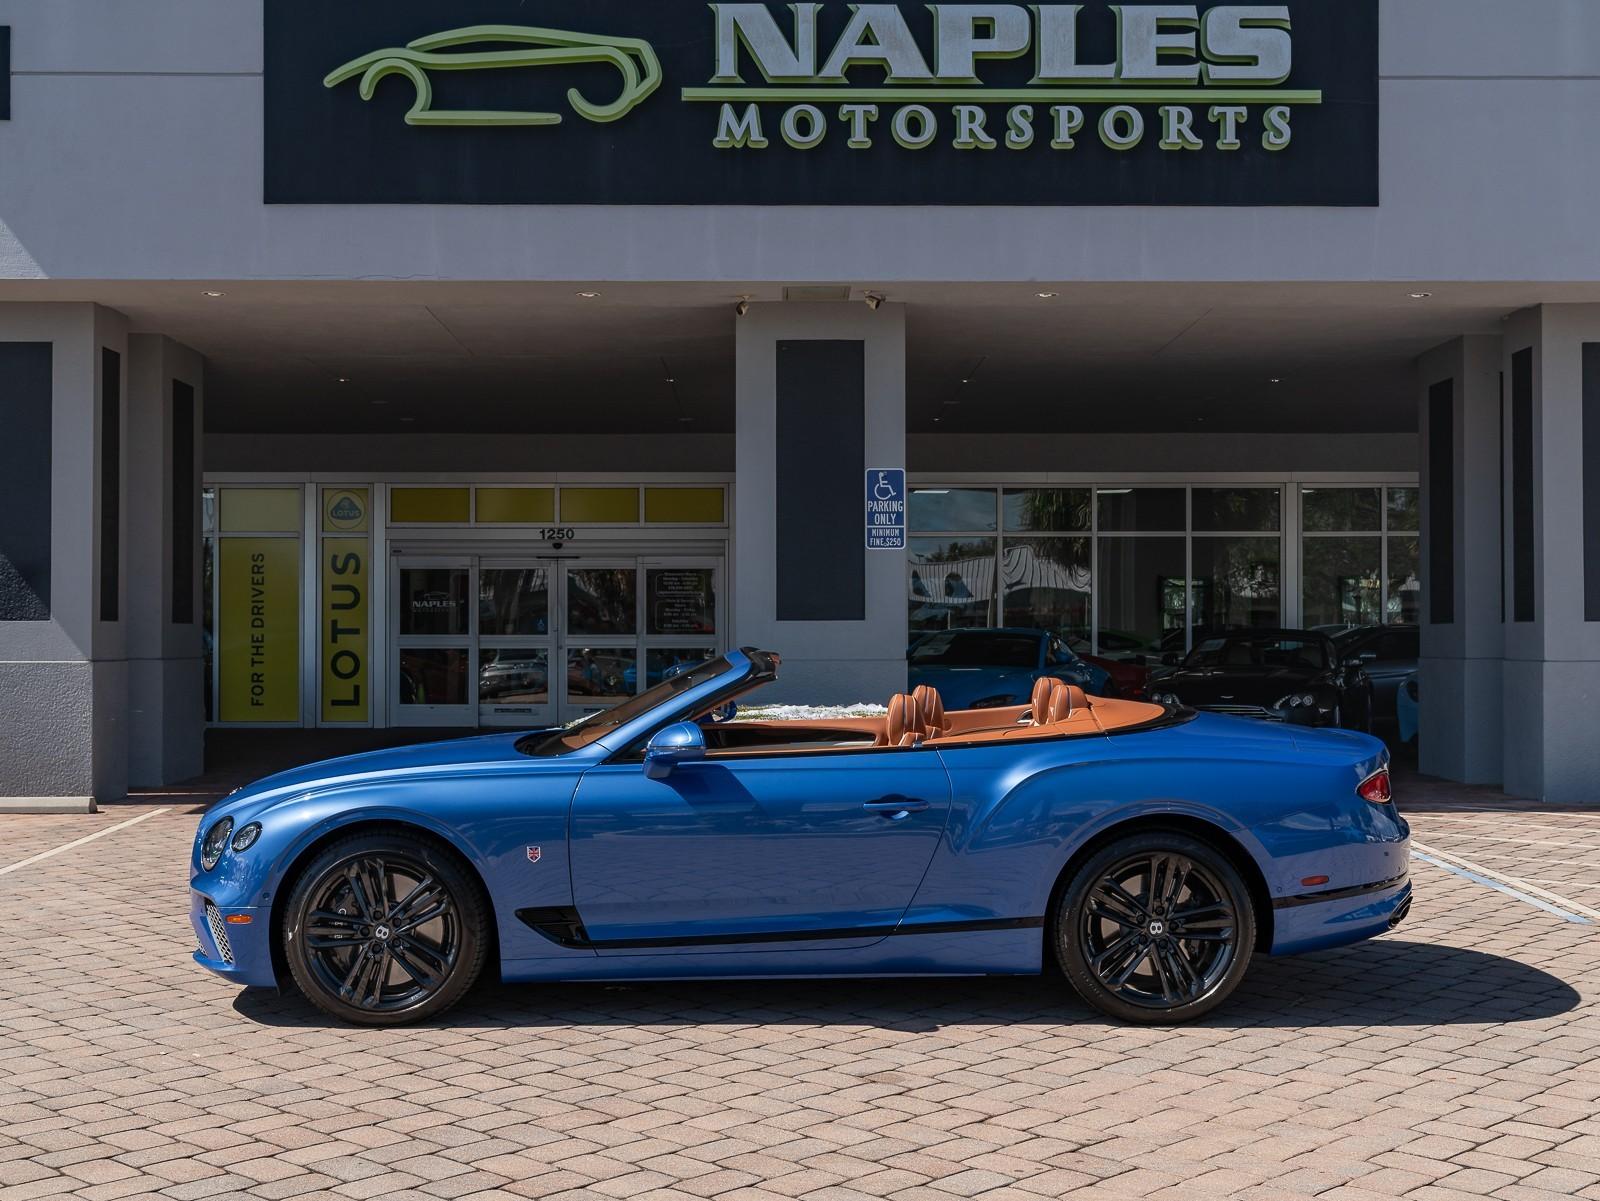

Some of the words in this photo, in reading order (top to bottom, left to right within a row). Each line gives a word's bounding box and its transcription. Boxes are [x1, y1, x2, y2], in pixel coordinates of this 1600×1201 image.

[708, 3, 1293, 85] NAPLES
[712, 103, 1293, 150] MOTORSPORTS
[867, 501, 904, 512] PARKING
[332, 509, 361, 518] LOTUS
[874, 513, 897, 525] ONLY
[539, 528, 575, 540] 1250
[871, 528, 900, 537] MINIMUM
[869, 537, 884, 546] FINE
[886, 537, 902, 546] $250
[250, 552, 265, 629] DRIVERS
[412, 600, 457, 608] NAPLES
[330, 552, 361, 707] LOTUS
[250, 633, 265, 667] THE
[250, 672, 265, 707] FOR
